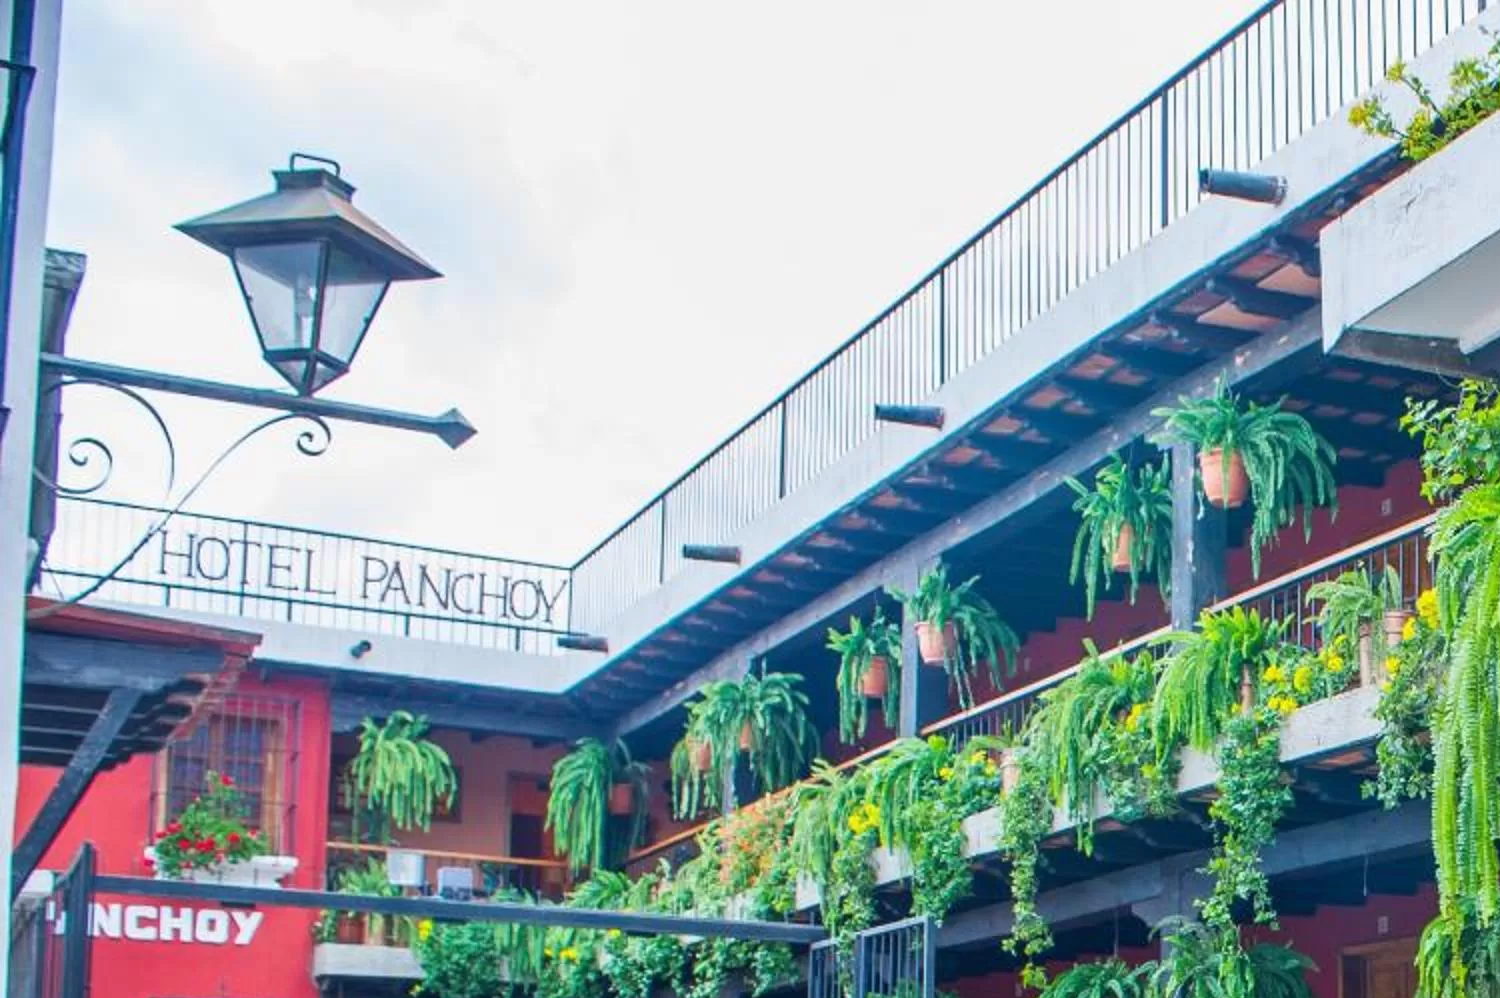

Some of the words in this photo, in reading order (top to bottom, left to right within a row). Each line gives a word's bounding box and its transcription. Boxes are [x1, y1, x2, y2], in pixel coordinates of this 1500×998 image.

[159, 530, 337, 595] HOTEL
[361, 555, 568, 624] PANCHOY
[46, 901, 264, 945] NCHOY
